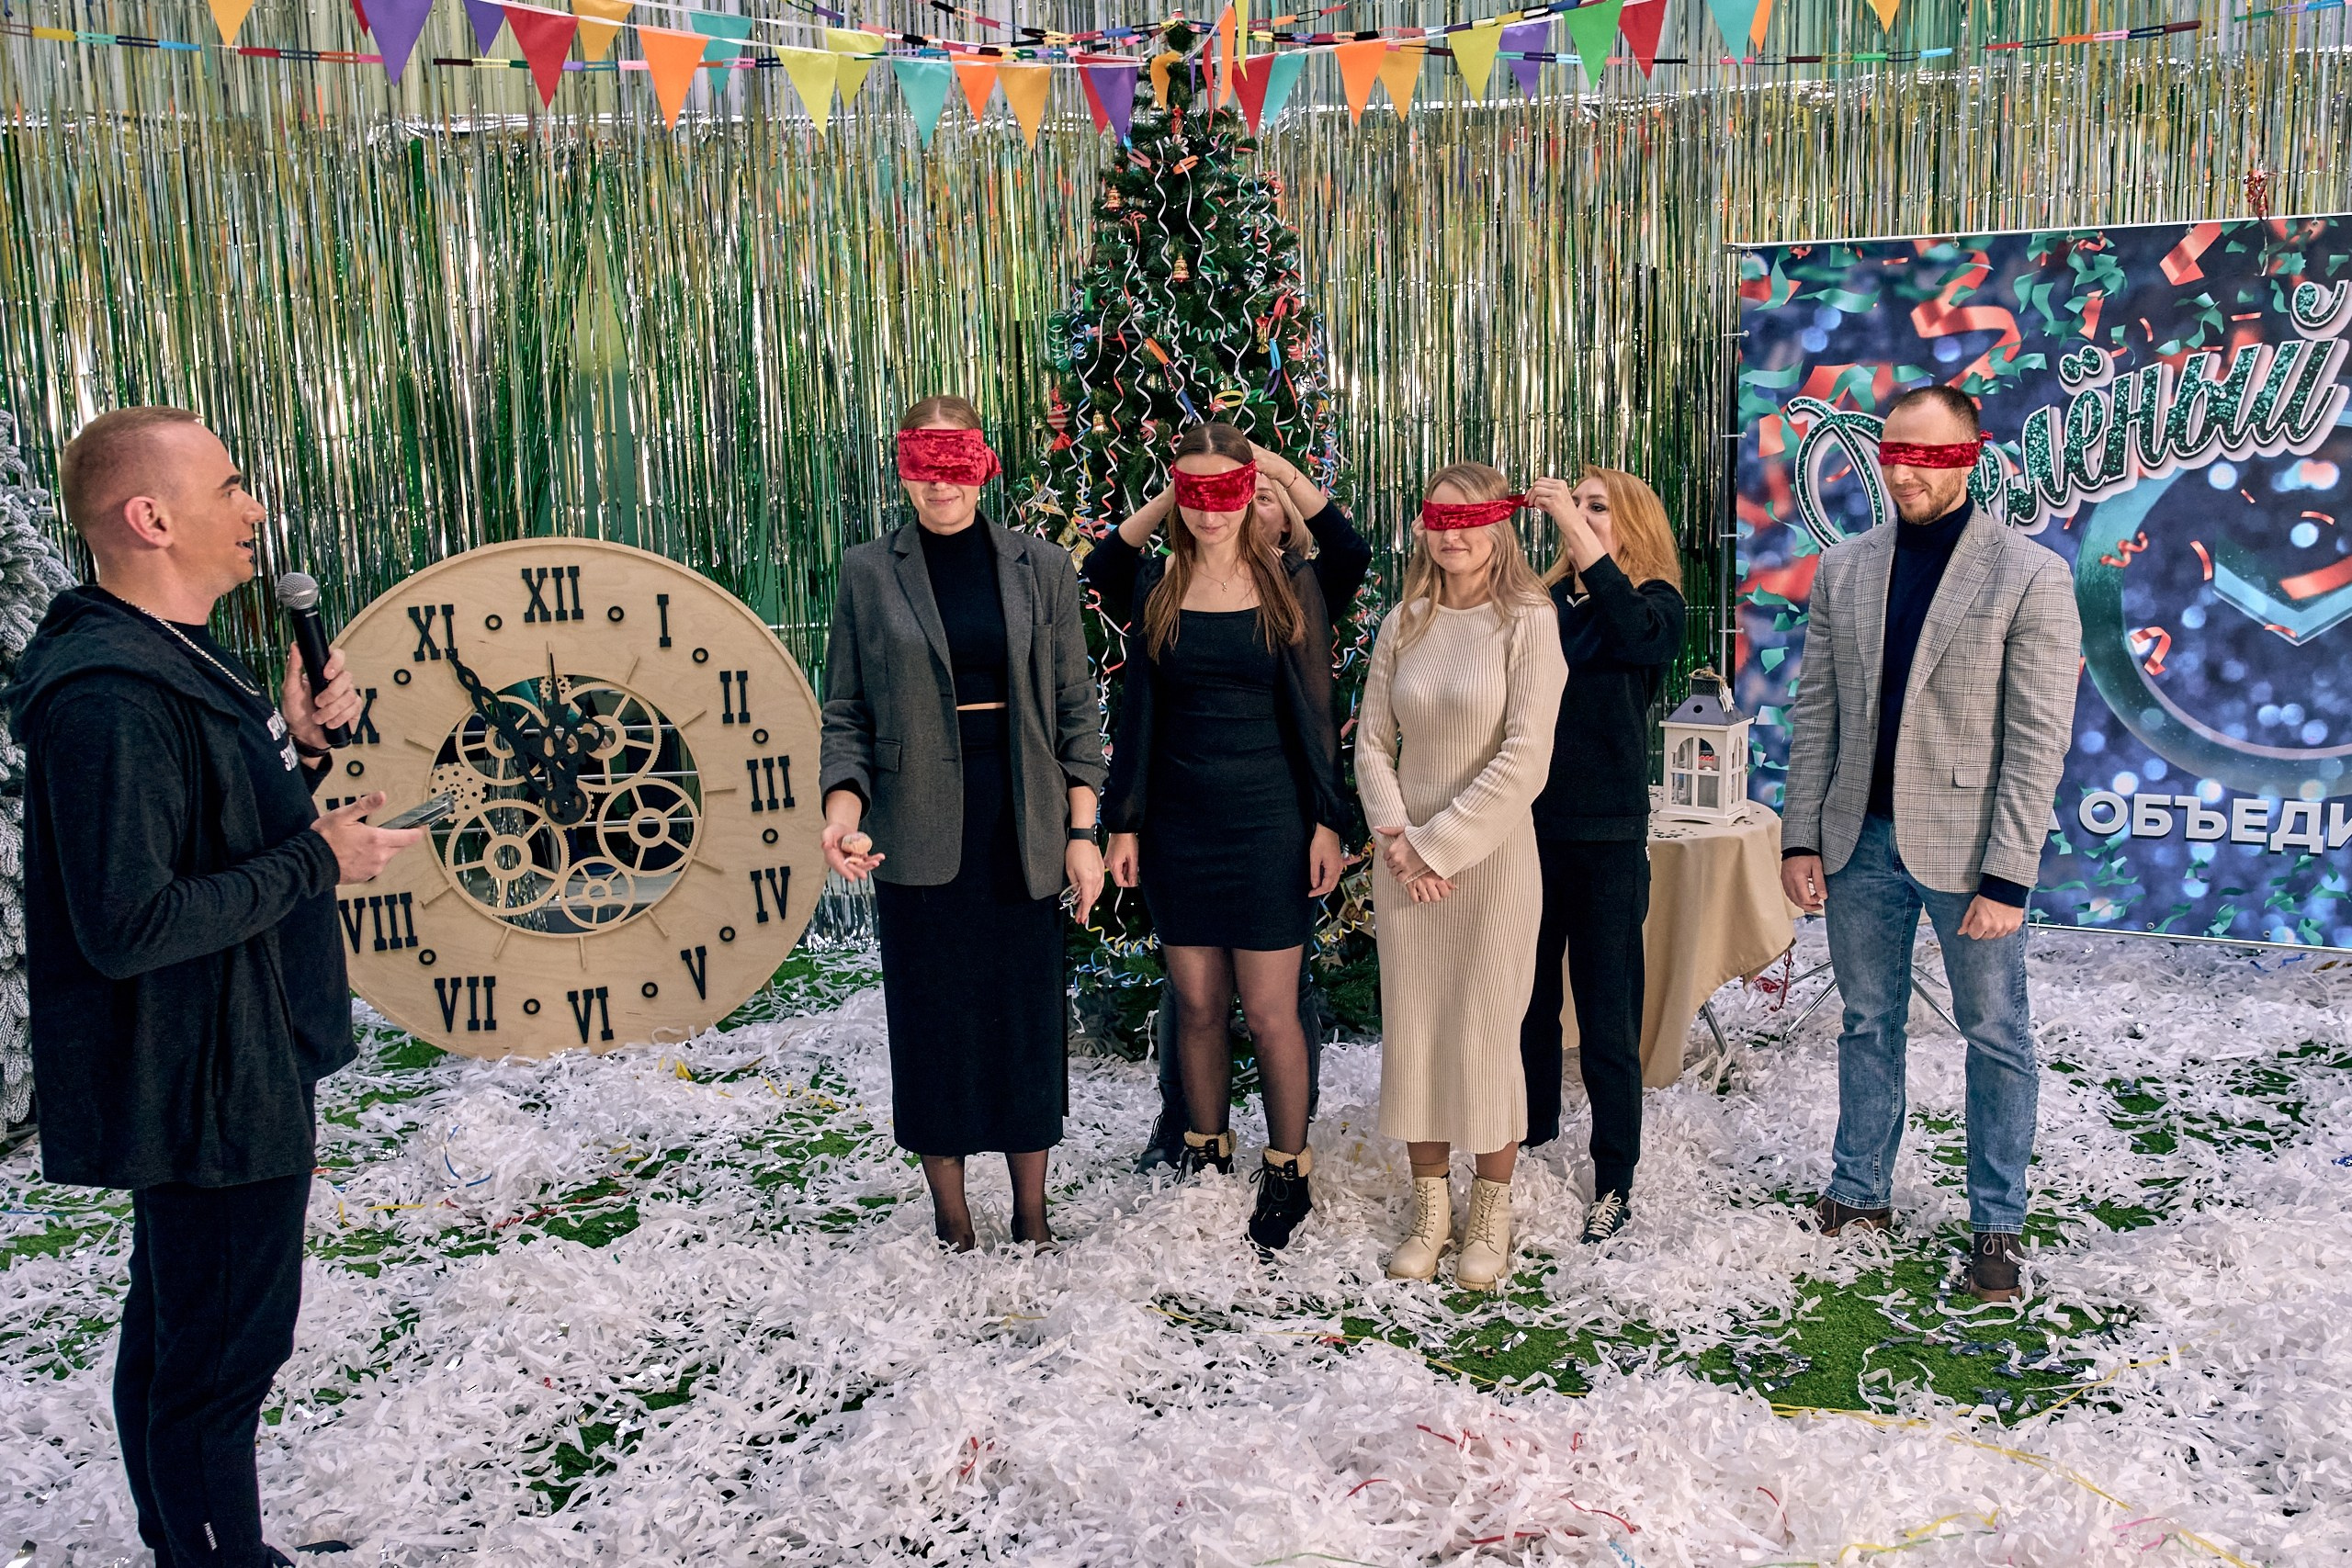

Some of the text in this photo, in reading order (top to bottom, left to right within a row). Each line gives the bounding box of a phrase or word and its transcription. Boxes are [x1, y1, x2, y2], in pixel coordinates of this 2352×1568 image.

[521, 565, 584, 624] XII
[656, 593, 672, 649] I
[407, 604, 457, 661] XI
[719, 670, 751, 725] II
[746, 754, 796, 813] III
[337, 891, 419, 954] VIII
[750, 865, 791, 924] IV
[680, 945, 707, 1000] V
[434, 976, 497, 1033] VII
[567, 986, 615, 1044] VI
